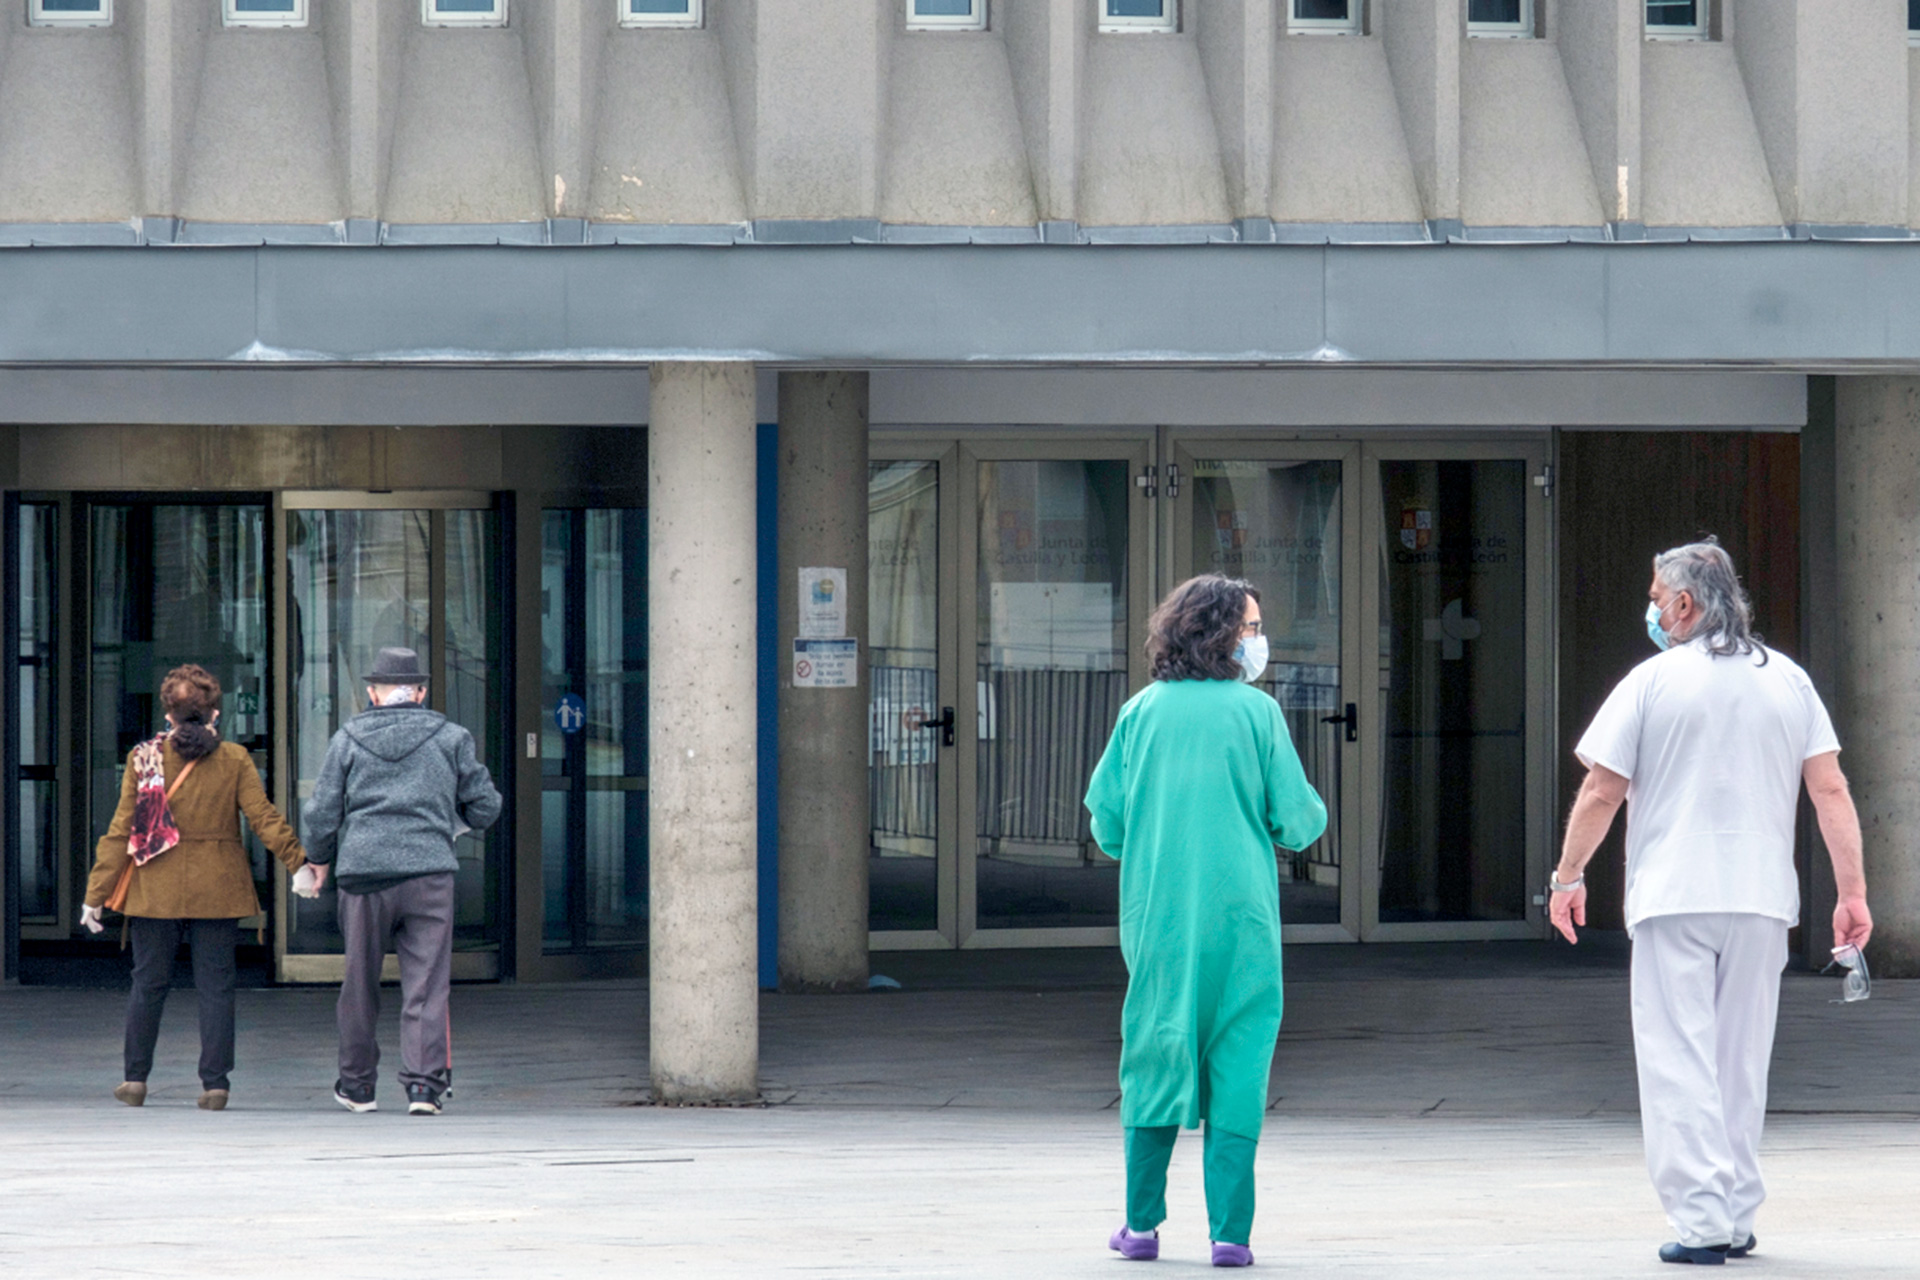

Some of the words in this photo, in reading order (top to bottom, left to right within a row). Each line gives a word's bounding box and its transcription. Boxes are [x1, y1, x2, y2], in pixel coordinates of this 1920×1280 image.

[1038, 536, 1083, 549] Junta
[1255, 535, 1297, 549] Junta
[1303, 535, 1323, 549] de
[1487, 534, 1507, 548] de
[996, 551, 1052, 565] Castilla
[1057, 554, 1067, 567] y
[1210, 550, 1267, 564] Castilla
[1272, 553, 1282, 567] y
